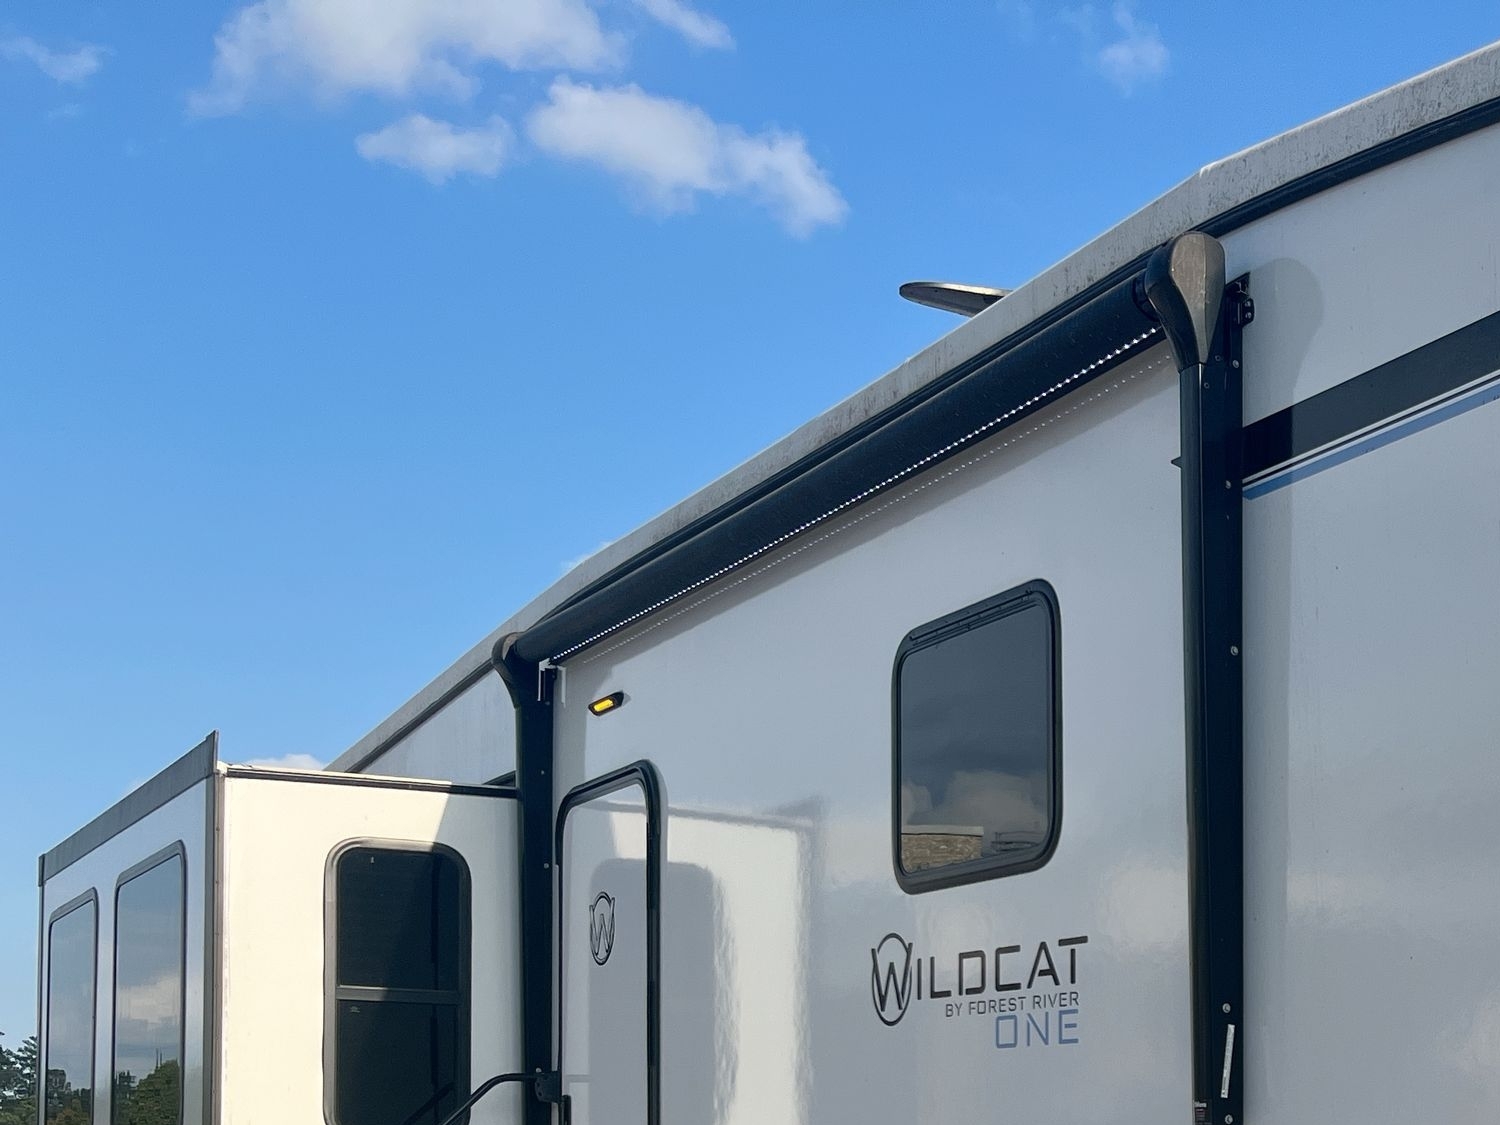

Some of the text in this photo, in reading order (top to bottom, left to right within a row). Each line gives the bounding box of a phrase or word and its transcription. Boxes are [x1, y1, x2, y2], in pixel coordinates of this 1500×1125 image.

[871, 934, 1089, 1016] WILDCAT
[945, 991, 1080, 1017] BY FOREST RIVER
[995, 1009, 1079, 1049] ONE
